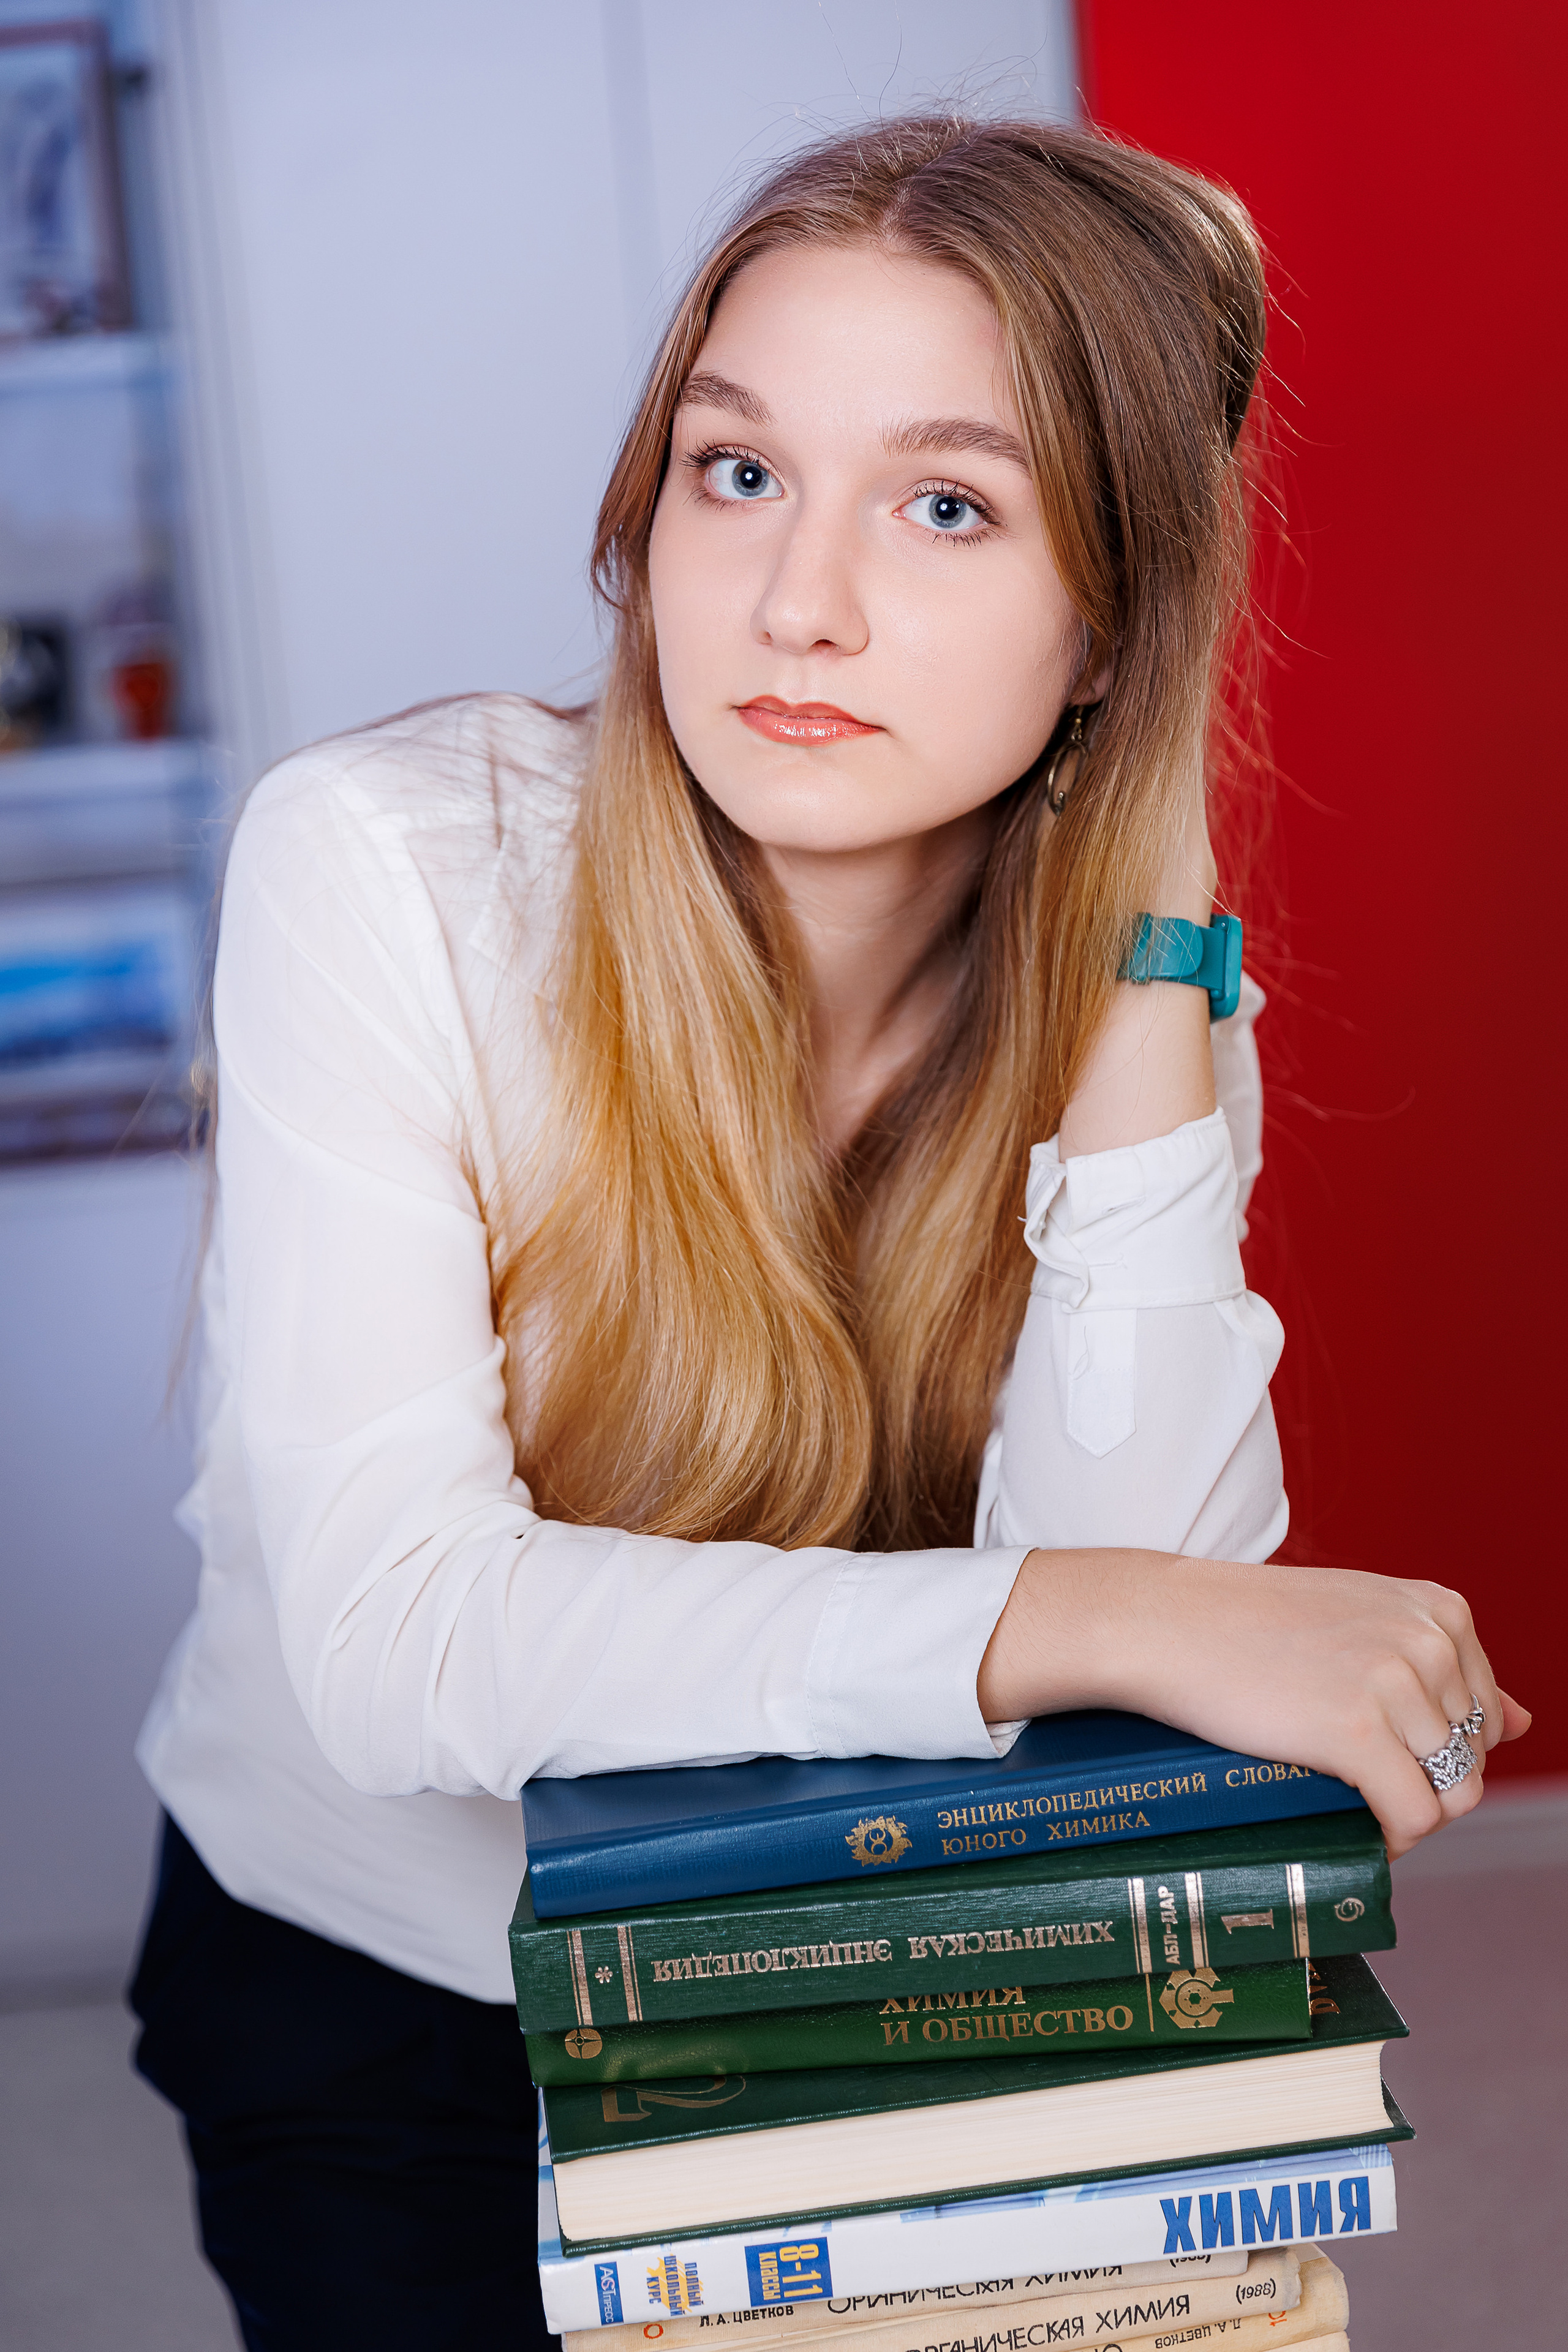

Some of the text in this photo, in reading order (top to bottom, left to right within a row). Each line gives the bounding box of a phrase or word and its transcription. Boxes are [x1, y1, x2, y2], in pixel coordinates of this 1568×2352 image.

[937, 1762, 1321, 1830] ЭНЦИКЛОПЕДИЧЕСКИЙ СЛОВА
[943, 1811, 1150, 1856] ЮНОГО ХИМИКА
[1158, 1885, 1181, 1966] АБЛ-ДАР
[1221, 1909, 1275, 1935] 1
[650, 1920, 1115, 1982] ХИМИЧЕСКАЯ ЭНЦИКЛОПЕДИЯ
[880, 2005, 1134, 2046] И ОБЩЕСТВО
[1159, 2176, 1372, 2255] ХИМИЯ
[646, 2275, 662, 2304] КУРС
[663, 2255, 685, 2316] ШКОЛЬНЫЙ
[684, 2262, 704, 2307] ПОЛНЫЙ
[779, 2243, 823, 2298] 8-11
[733, 2305, 794, 2324] ЦВЕТКОВ
[1096, 2294, 1190, 2334] ХИМИЯ
[1235, 2278, 1276, 2305] (1988)
[1155, 2324, 1212, 2350] ЦВЕТКОВ
